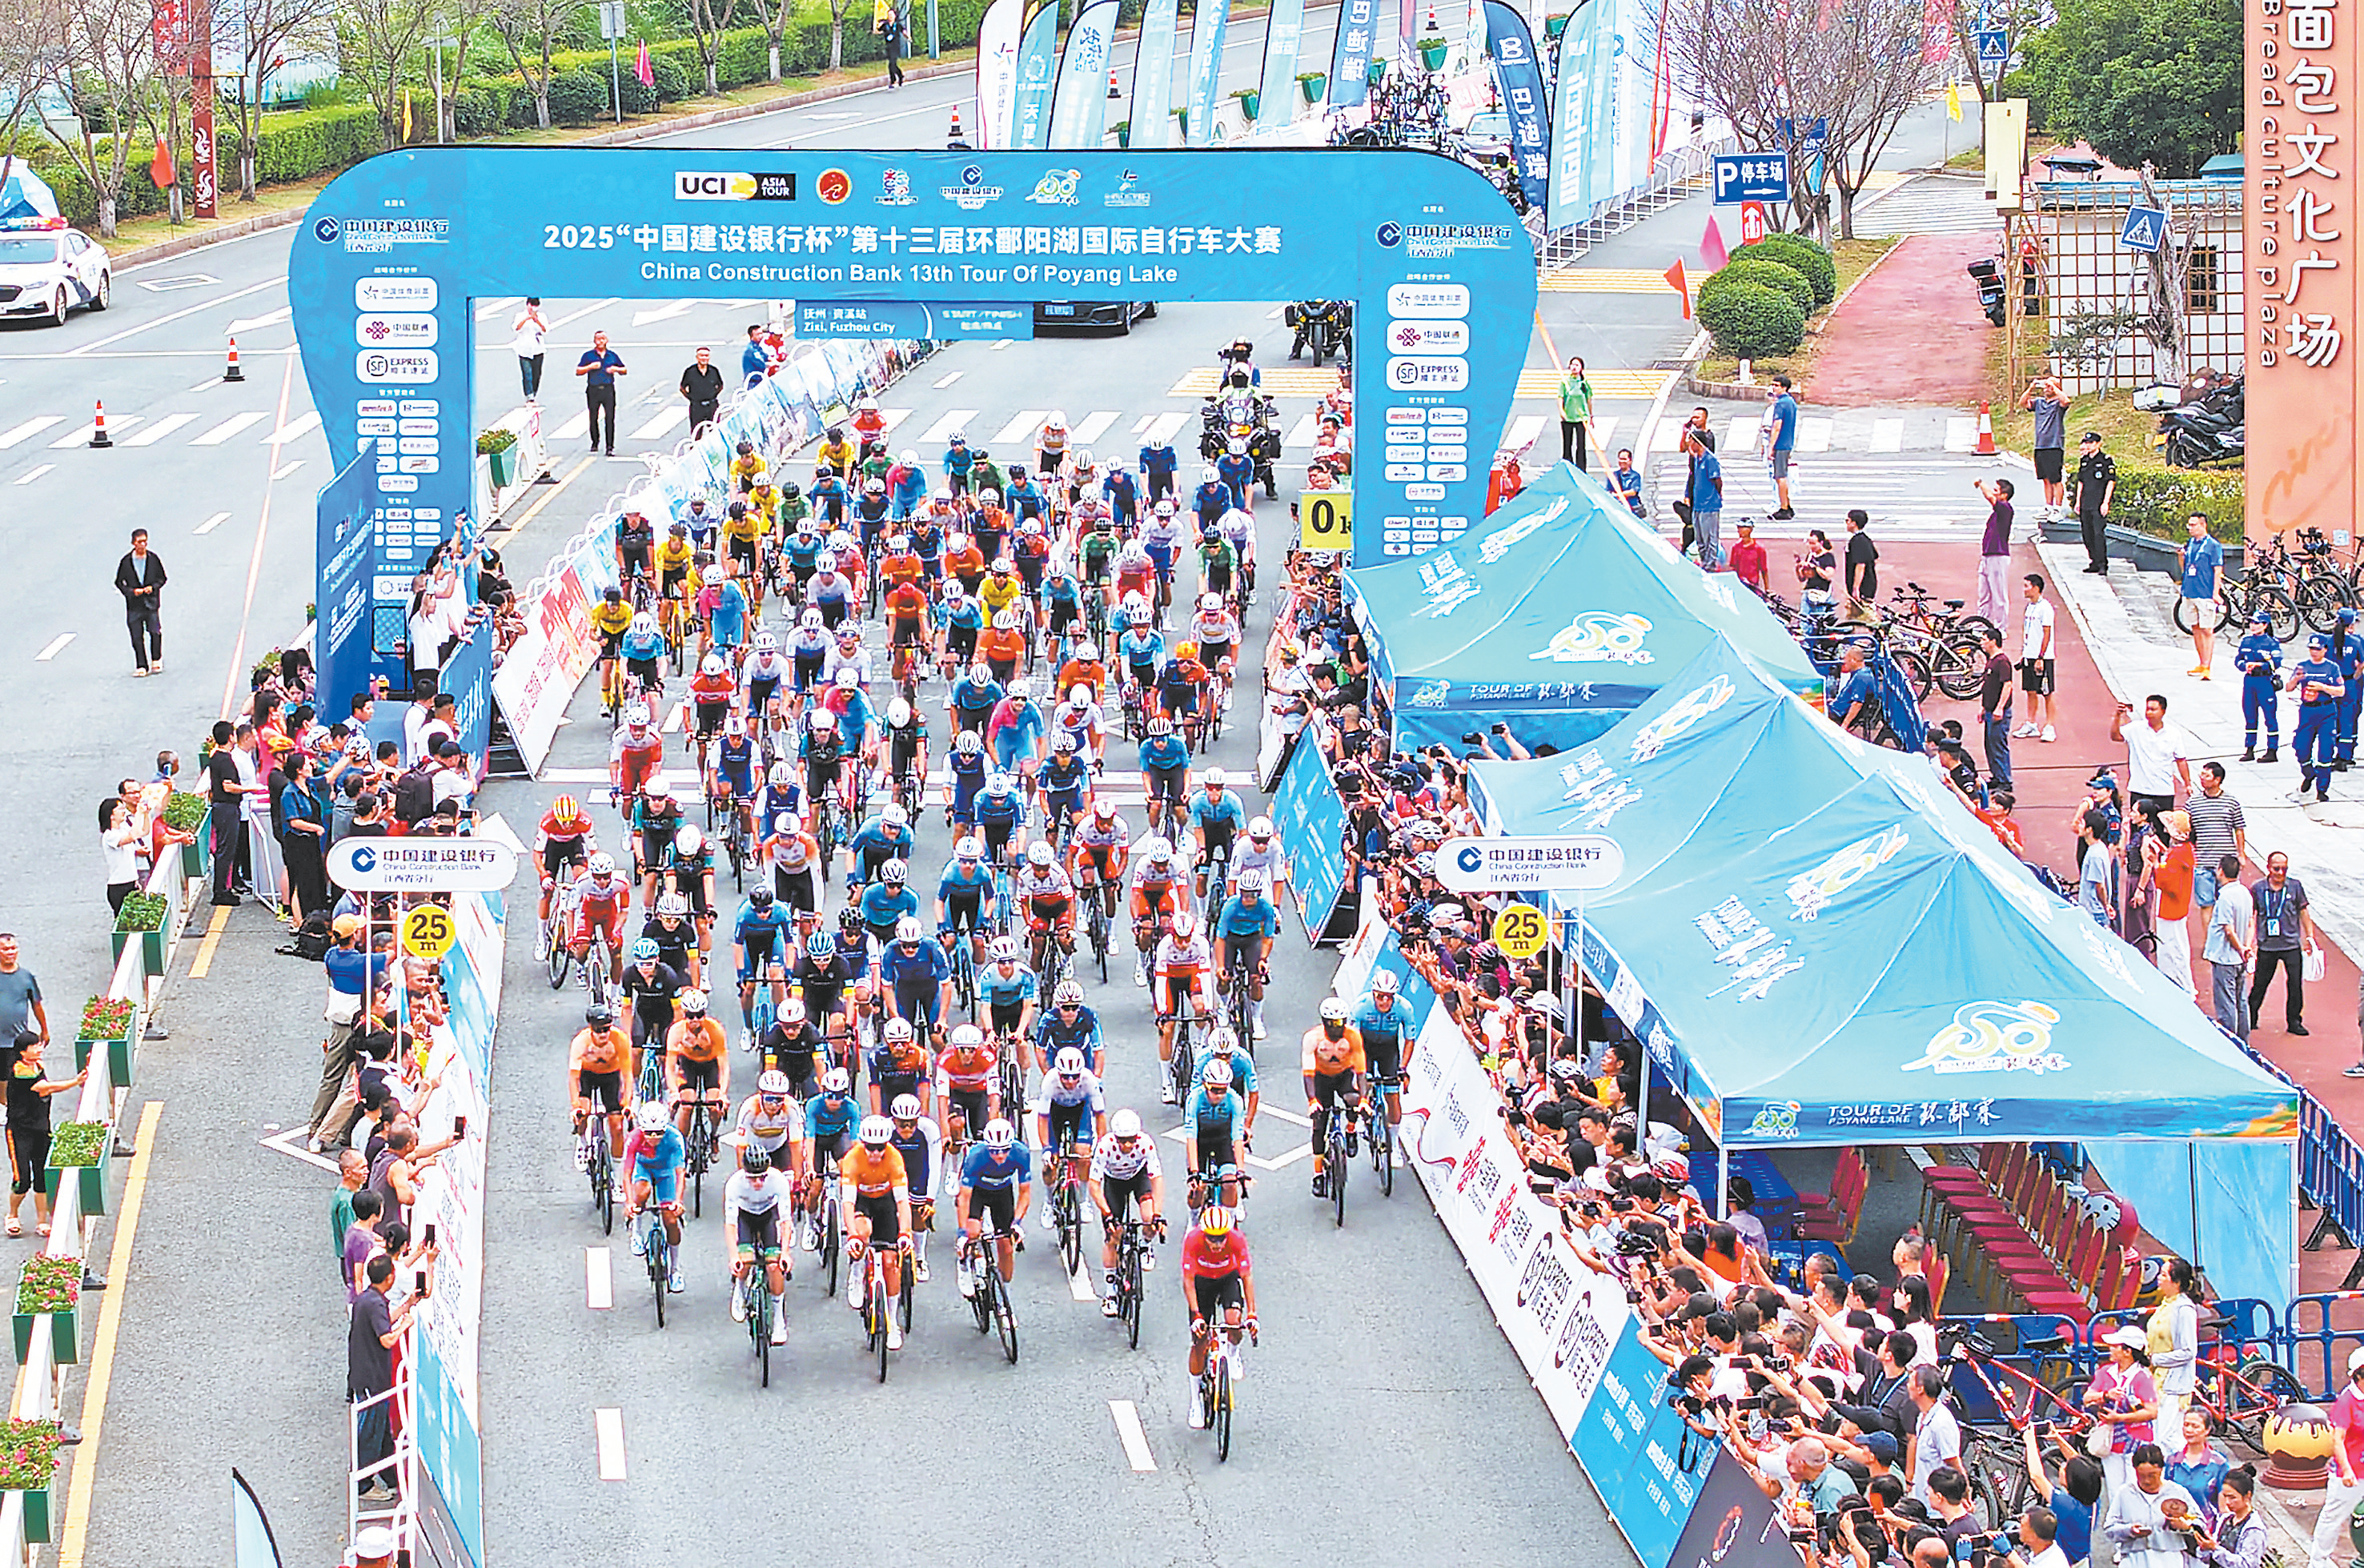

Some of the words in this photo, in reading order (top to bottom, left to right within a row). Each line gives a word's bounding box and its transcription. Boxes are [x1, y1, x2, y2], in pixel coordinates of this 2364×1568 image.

[1511, 87, 1548, 179] 巴迪瑞
[1741, 161, 1784, 183] 停车场
[683, 178, 725, 194] UCI
[761, 178, 786, 186] ASIA
[1717, 162, 1738, 197] P
[2262, 117, 2283, 255] culture
[2284, 0, 2340, 367] 面包文化广场
[761, 187, 789, 196] TOUR
[544, 223, 1281, 254] 2025“中国建设银行杯”第十三届环鄱阳湖国际自行车大赛
[1406, 225, 1511, 239] 中国建设银行
[641, 263, 700, 280] China
[708, 263, 842, 281] Construction
[850, 264, 902, 282] Bank
[910, 265, 953, 282] 13th
[960, 265, 1007, 282] Tour
[1013, 265, 1038, 282] Of
[1044, 265, 1122, 287] Poyang
[1129, 265, 1178, 282] Lake
[2256, 267, 2282, 367] plaza
[803, 322, 827, 333] Zixi,
[829, 322, 870, 332] Fuzhou
[873, 322, 895, 335] City
[371, 361, 383, 371] SF
[391, 358, 428, 366] EXPRESS
[1401, 368, 1414, 379] SF
[1311, 499, 1335, 534] 0
[1340, 515, 1351, 534] k
[1470, 684, 1512, 694] TOUR
[1515, 684, 1535, 693] OF
[383, 849, 495, 862] 中国建设银行
[1489, 848, 1600, 860] 中国建设银行
[383, 863, 406, 871] China
[409, 863, 458, 871] Construction
[1489, 862, 1512, 870] China
[1515, 862, 1563, 870] Construction
[411, 914, 447, 940] 25
[1503, 913, 1539, 939] 25
[420, 941, 437, 950] m
[1513, 940, 1530, 949] m
[1828, 1105, 1886, 1116] TOUR
[1888, 1104, 1915, 1115] OF
